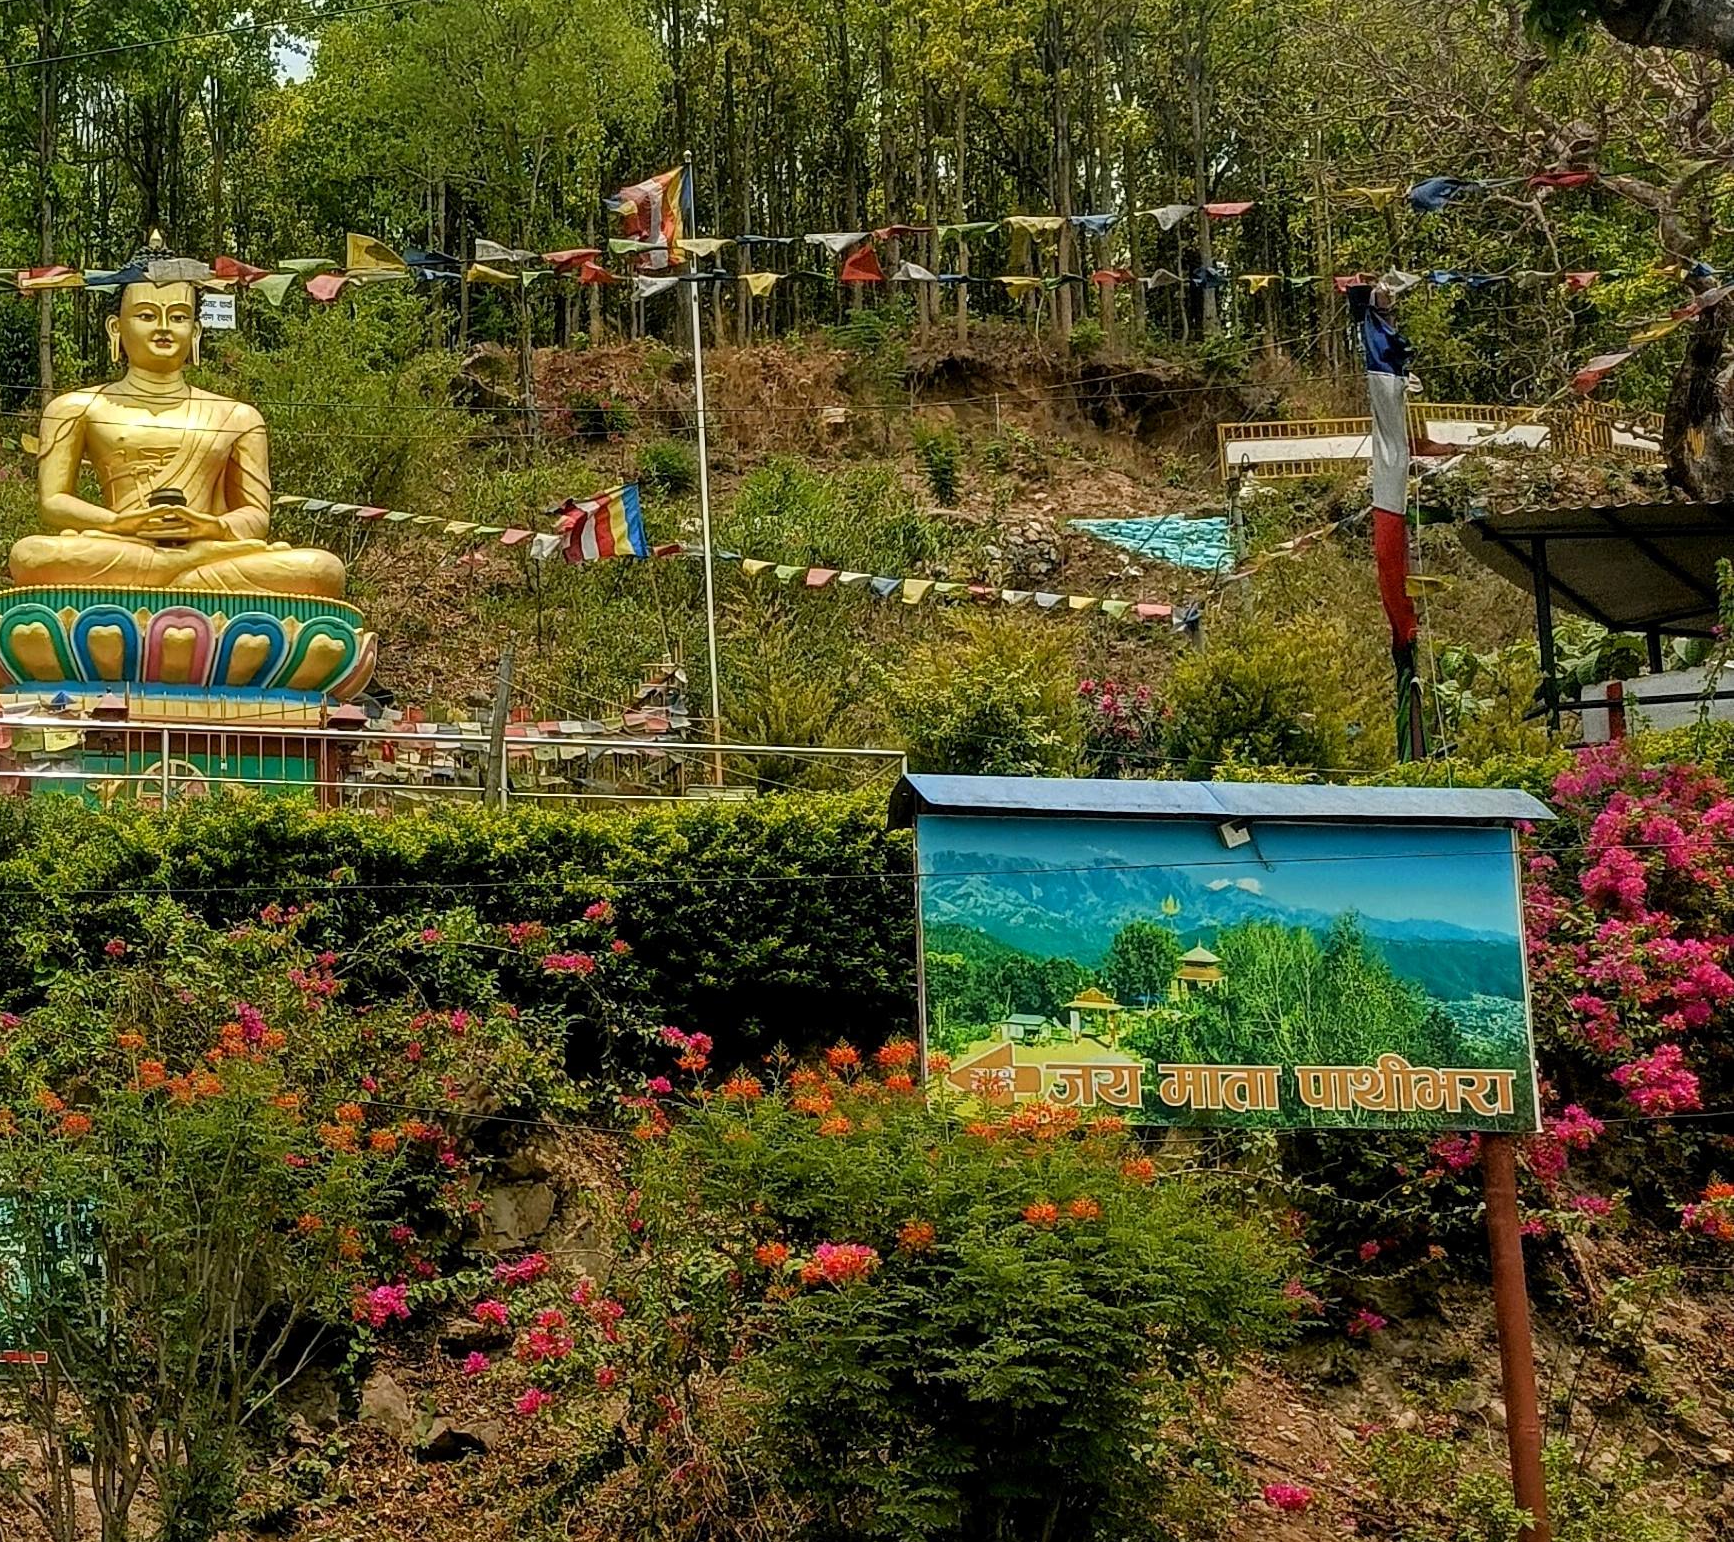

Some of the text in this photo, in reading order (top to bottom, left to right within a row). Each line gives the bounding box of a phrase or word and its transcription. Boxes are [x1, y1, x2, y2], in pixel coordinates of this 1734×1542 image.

[1045, 1052, 1516, 1116] जय माता पाथीभरा
